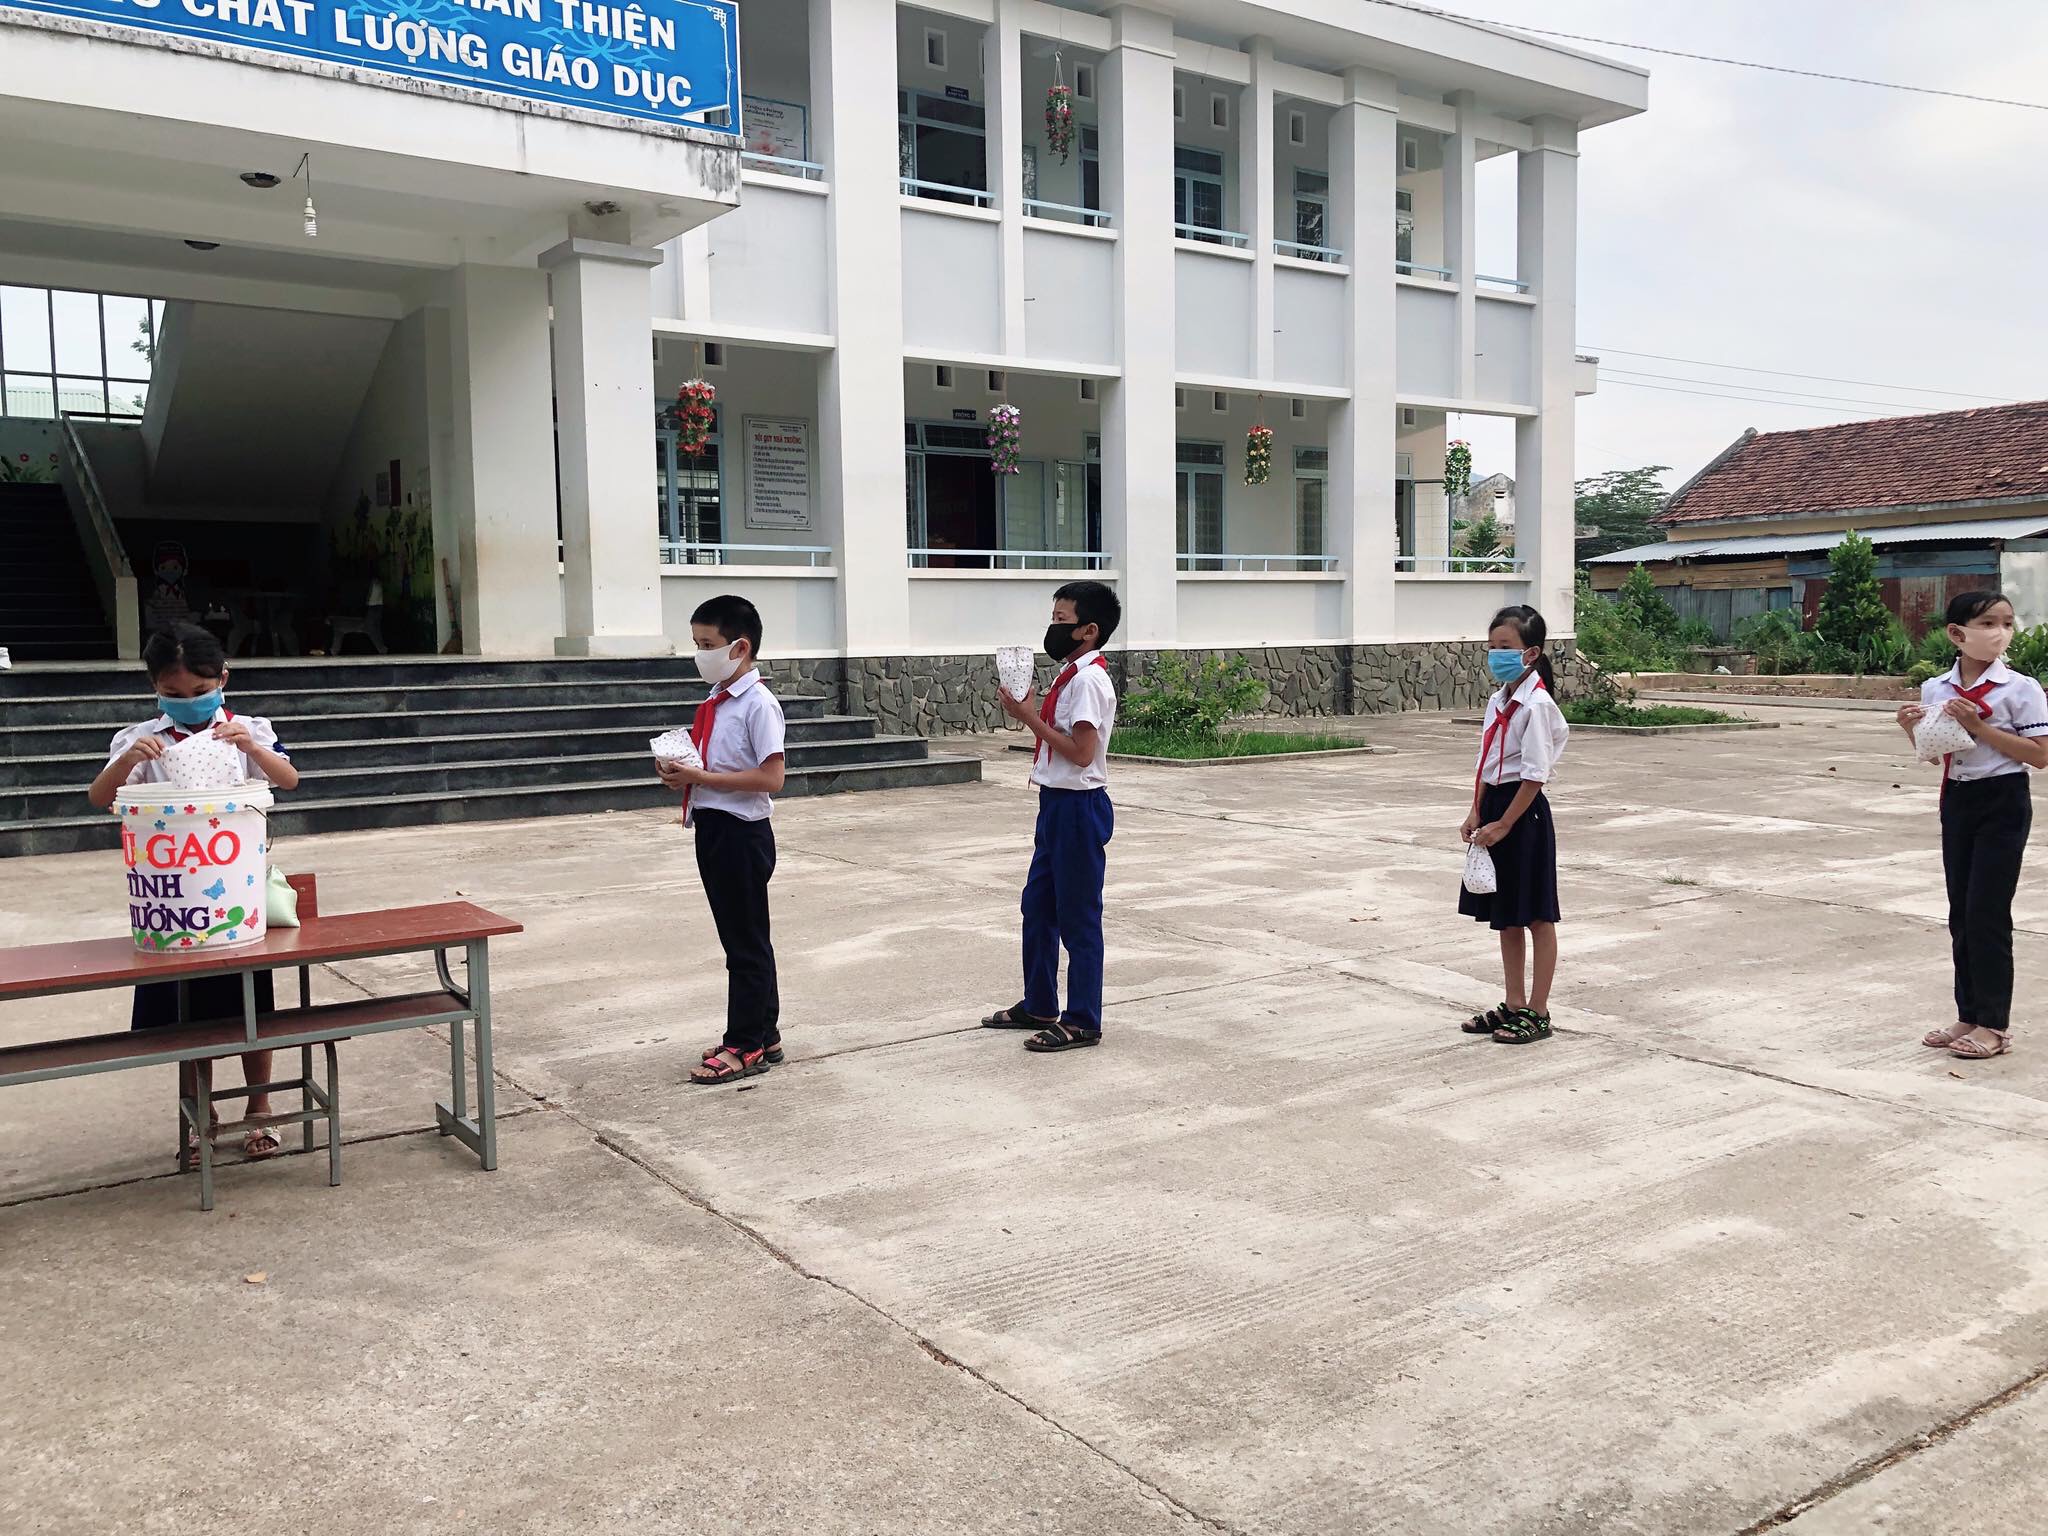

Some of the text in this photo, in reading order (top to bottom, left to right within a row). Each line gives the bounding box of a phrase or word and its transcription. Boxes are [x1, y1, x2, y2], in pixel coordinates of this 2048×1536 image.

[553, 0, 676, 50] THIỆN
[334, 8, 488, 70] LƯỢNG
[502, 42, 599, 90] GIÁO
[613, 64, 692, 109] DỤC
[146, 830, 241, 874] GẠO
[127, 867, 184, 898] TÌNH
